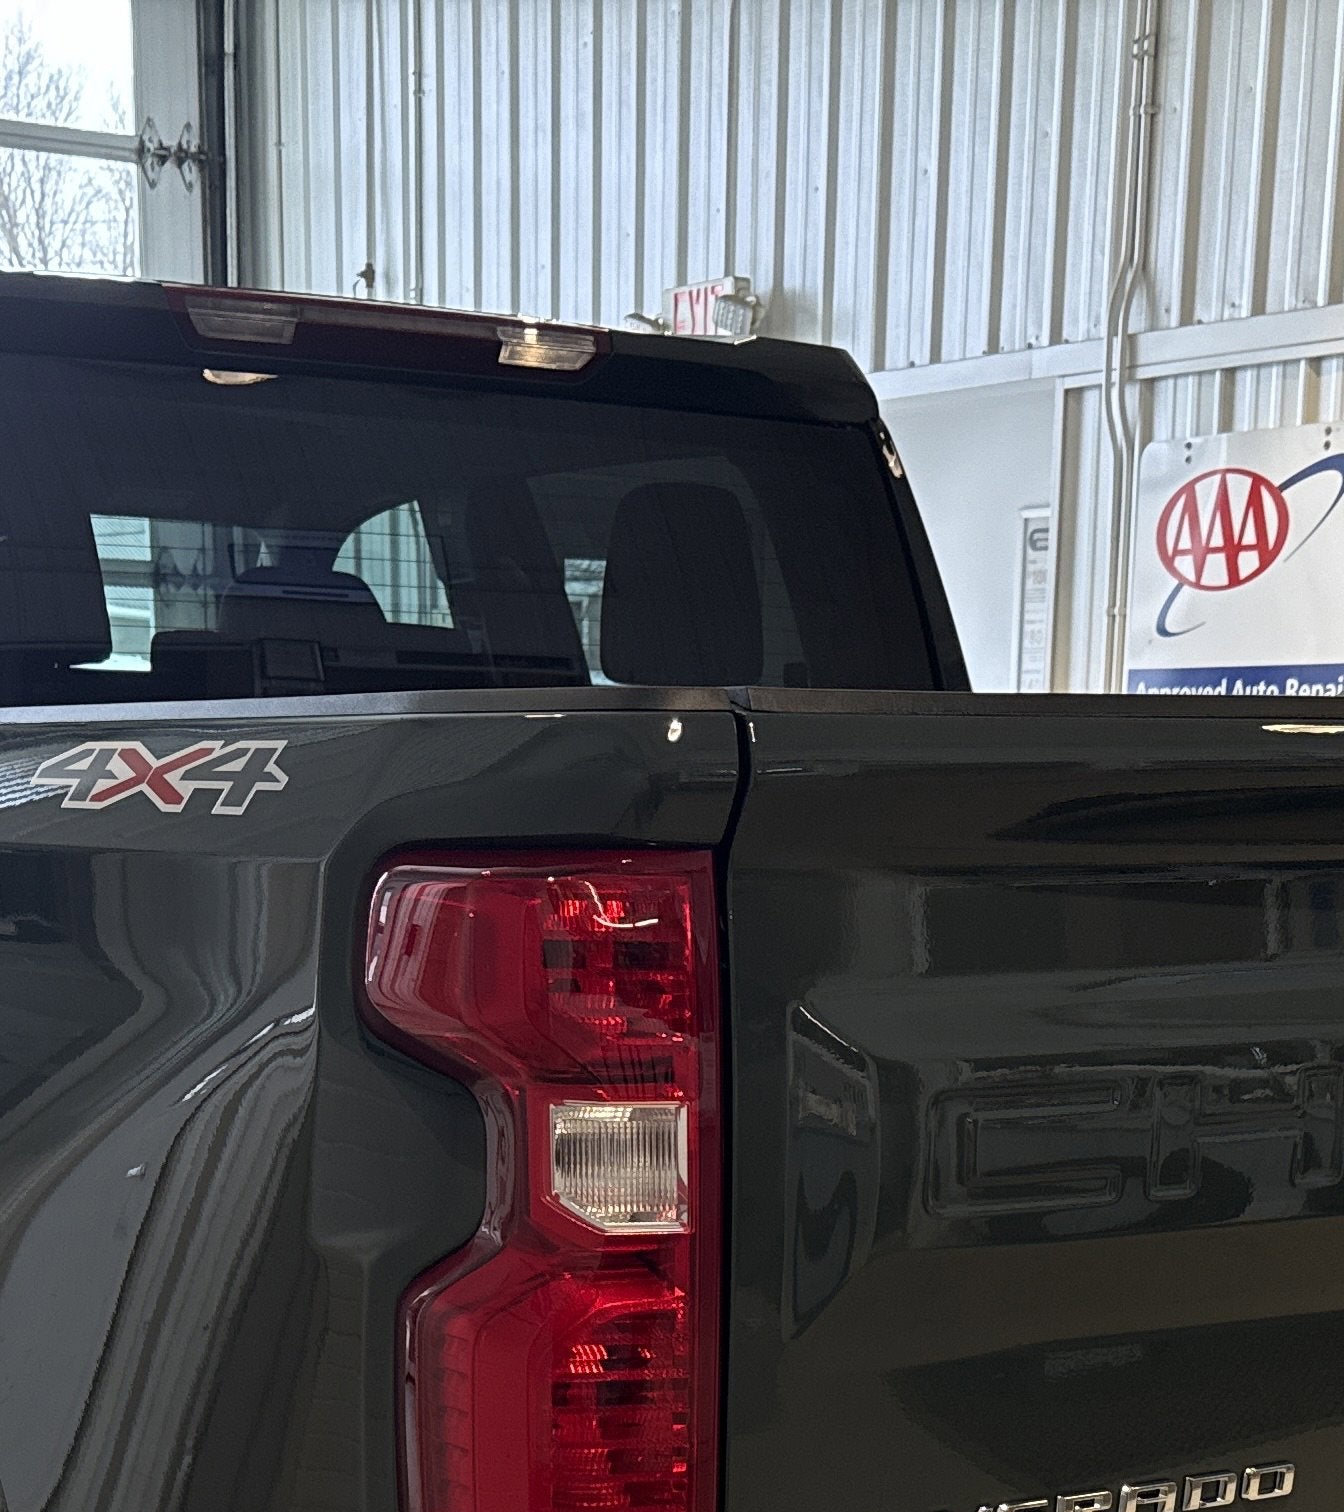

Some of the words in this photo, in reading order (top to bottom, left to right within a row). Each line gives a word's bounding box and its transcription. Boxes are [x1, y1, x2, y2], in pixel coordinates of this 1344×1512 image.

[674, 284, 724, 335] EXIT
[1161, 469, 1283, 590] AAA
[1232, 679, 1280, 696] Auto
